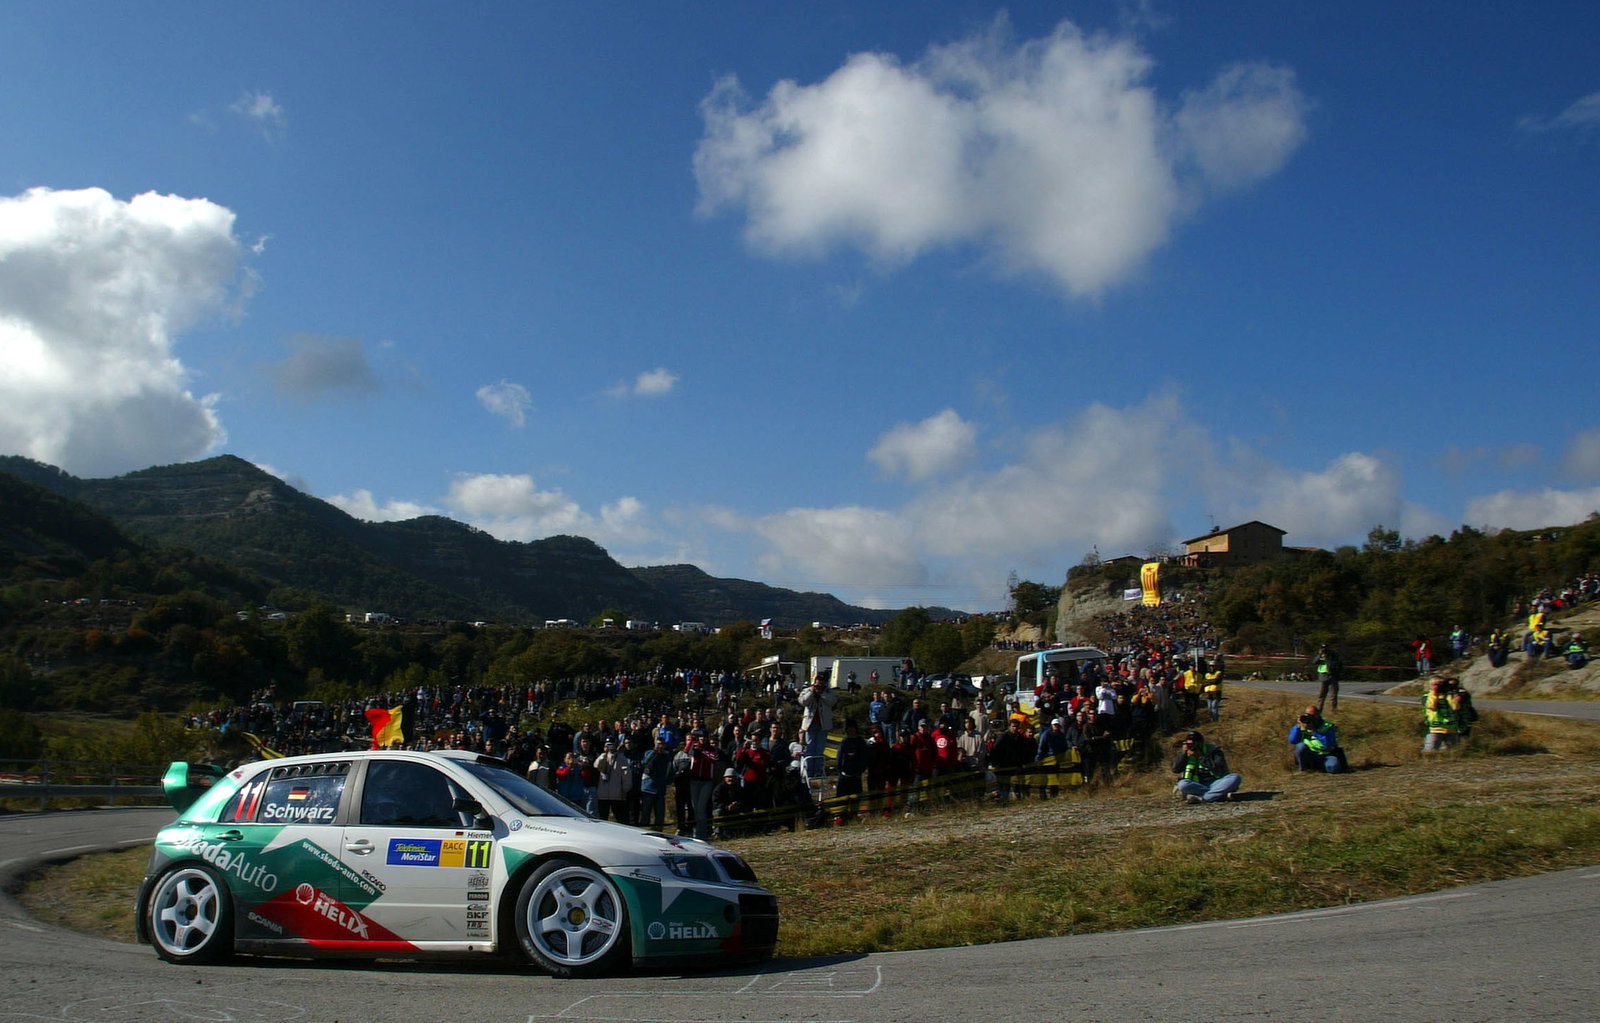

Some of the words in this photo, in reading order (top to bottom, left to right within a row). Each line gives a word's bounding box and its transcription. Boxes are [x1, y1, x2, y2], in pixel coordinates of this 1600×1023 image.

[234, 781, 264, 820] 11
[264, 803, 334, 819] Schwarz
[443, 843, 464, 851] RACC
[469, 841, 490, 868] 11
[302, 842, 376, 896] www.skoda-auto.com
[247, 911, 283, 935] SCANIA
[313, 898, 369, 940] HELIX
[466, 911, 489, 919] SKF
[669, 923, 719, 939] HELIX
